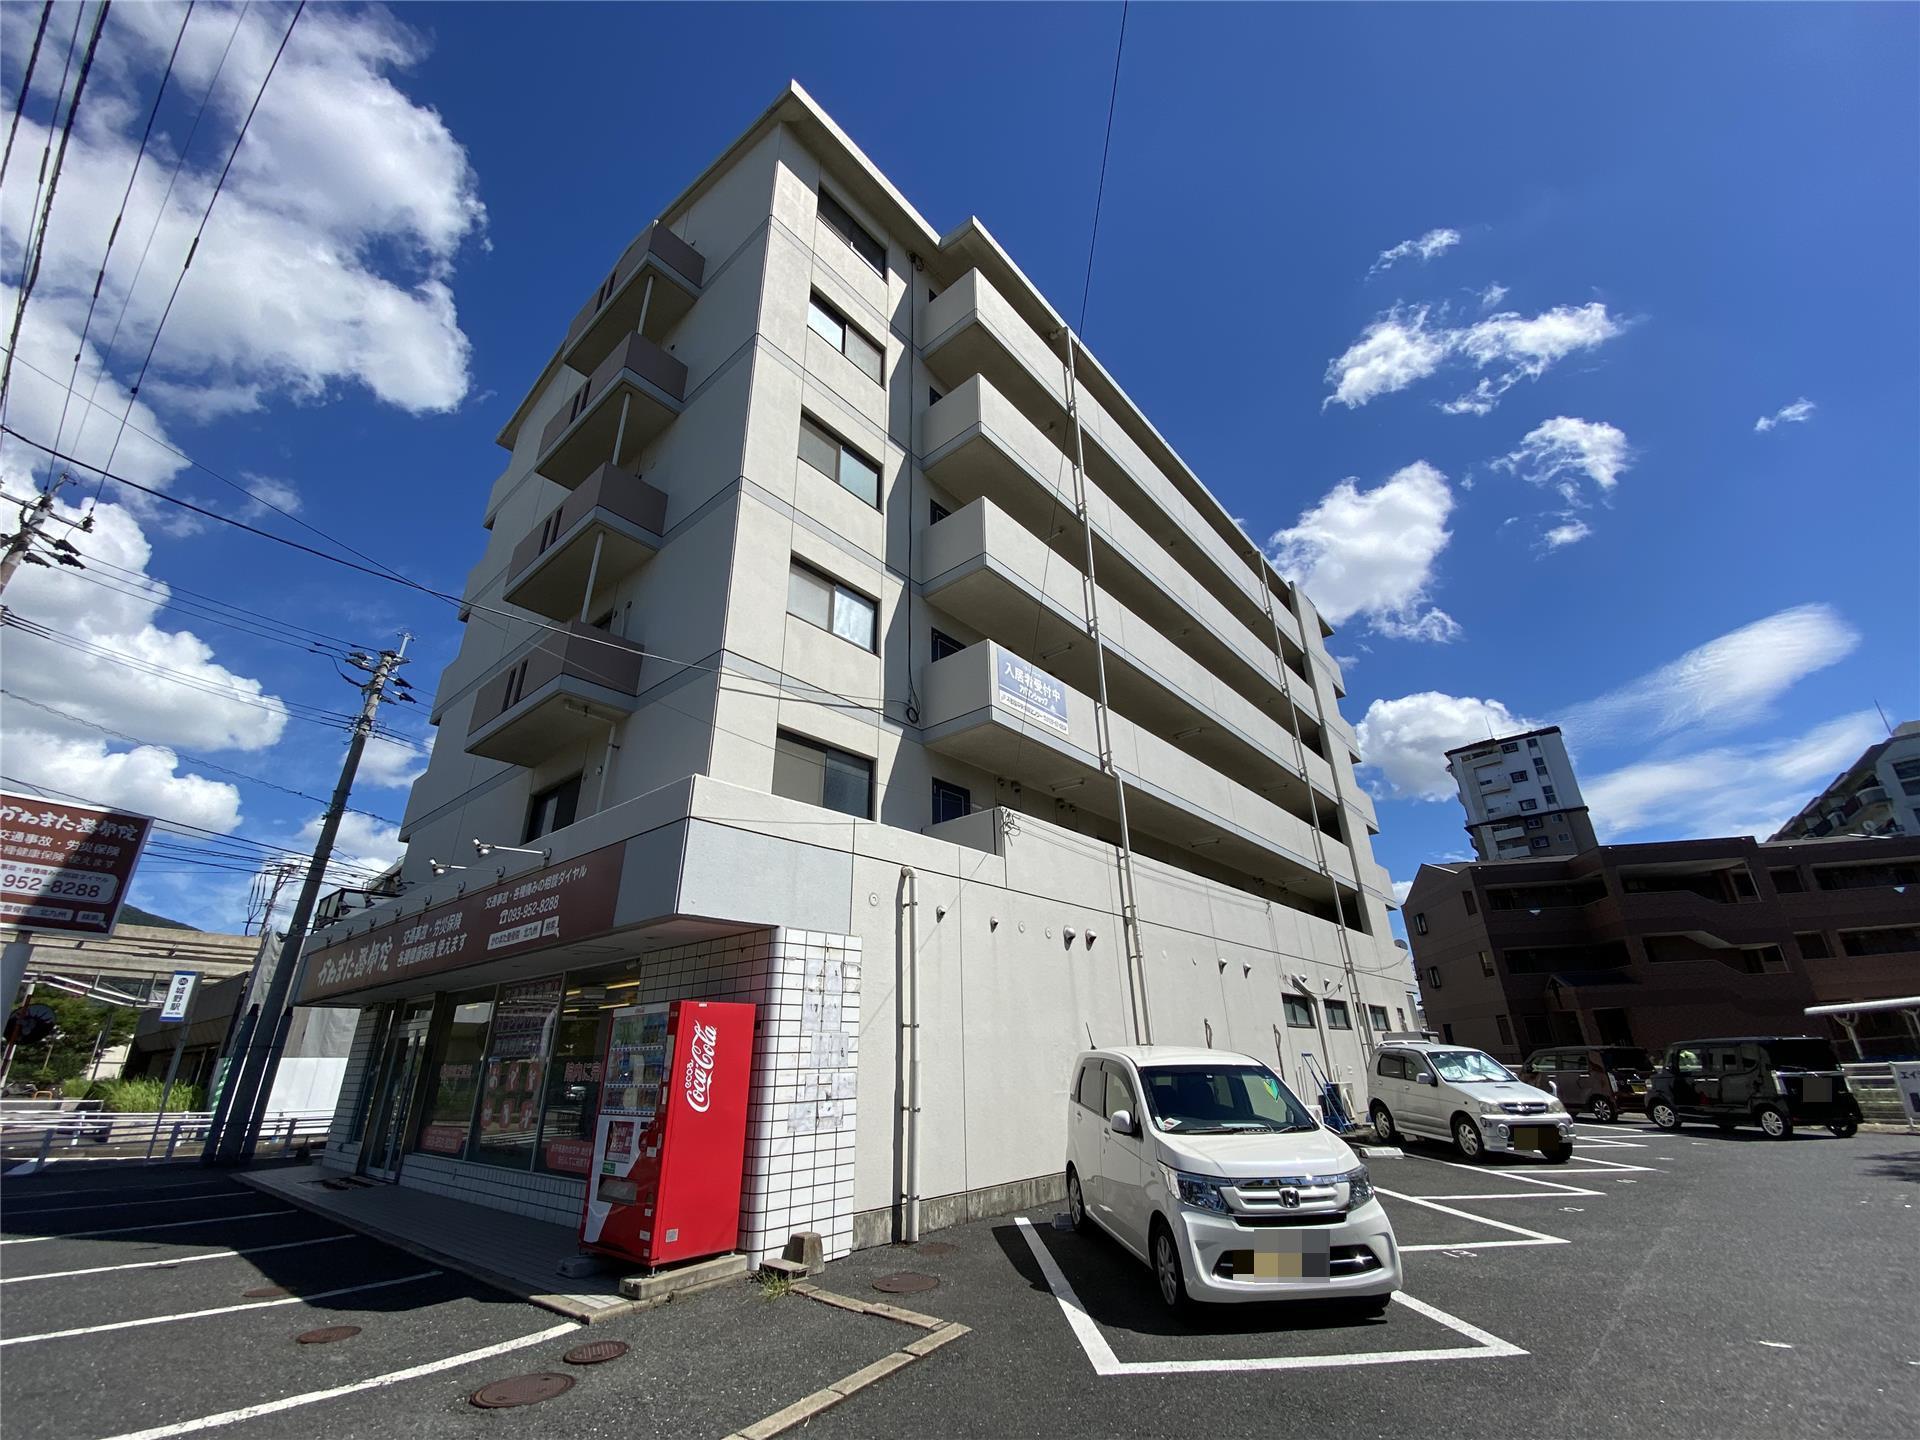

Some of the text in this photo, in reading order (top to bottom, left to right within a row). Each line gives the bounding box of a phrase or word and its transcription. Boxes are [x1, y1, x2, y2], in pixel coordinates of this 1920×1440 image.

[1004, 661, 1061, 703] 入居者受付中
[0, 844, 65, 863] 種健康保険
[2, 874, 101, 898] 952-8288
[508, 895, 560, 924] 093-952-8288
[436, 932, 468, 958] 使えます
[686, 1019, 718, 1113] Coca-Cola
